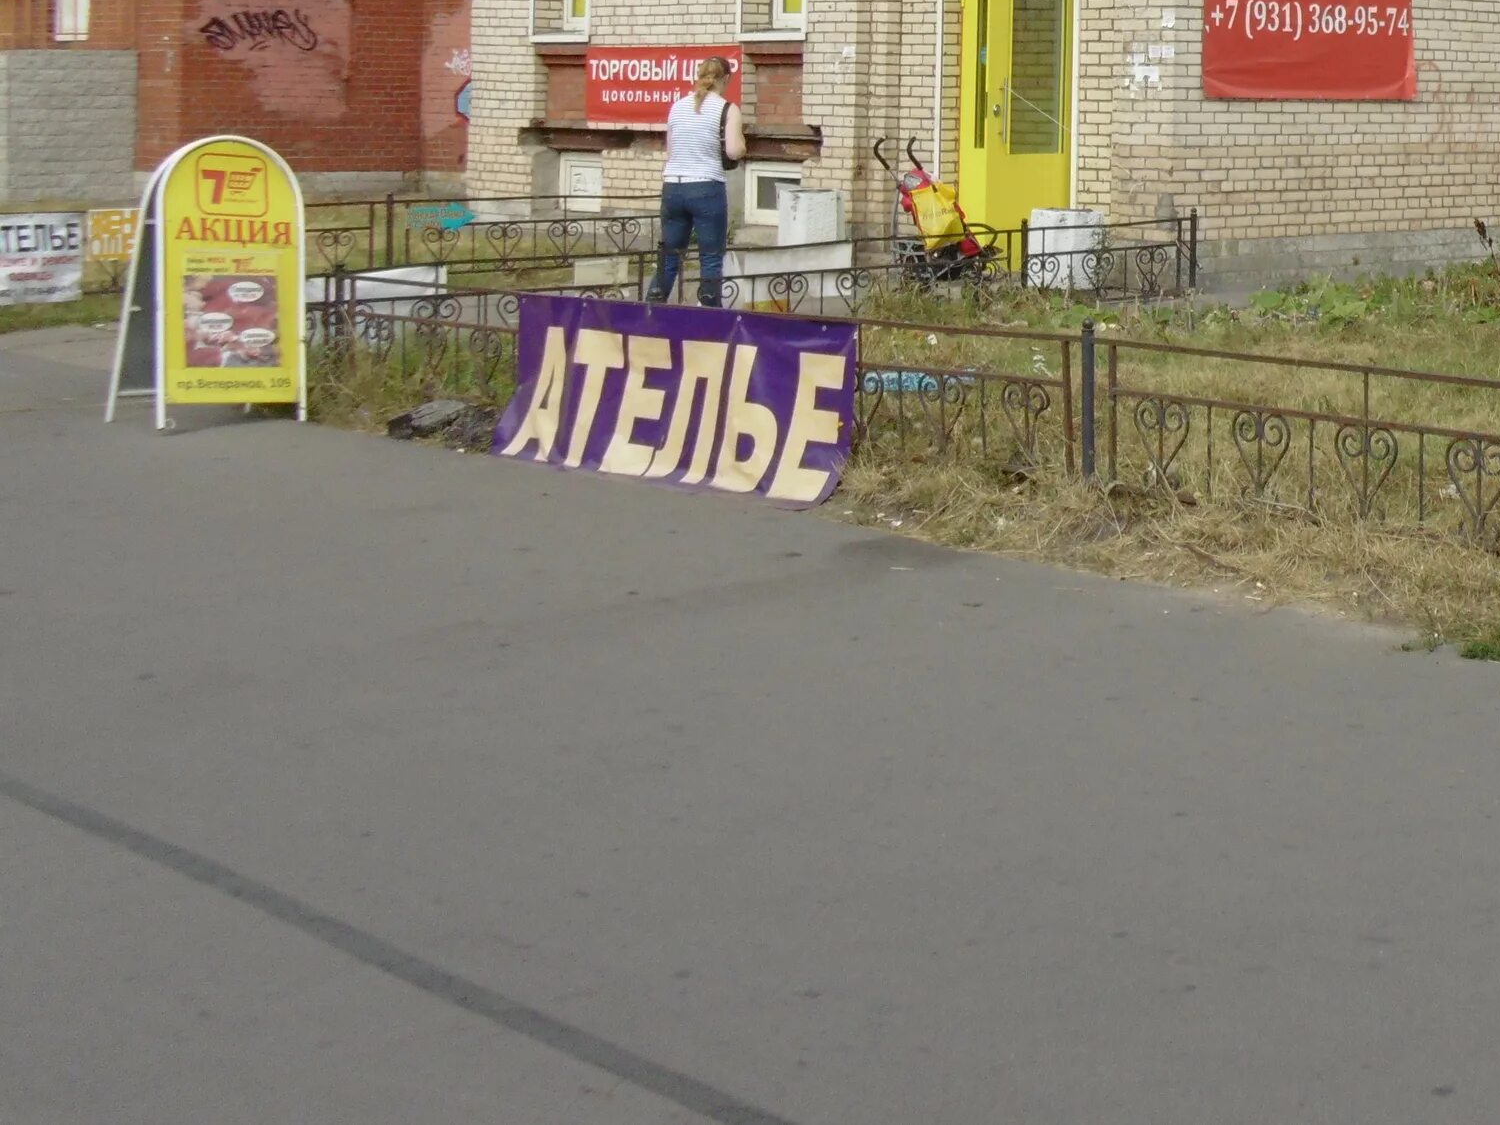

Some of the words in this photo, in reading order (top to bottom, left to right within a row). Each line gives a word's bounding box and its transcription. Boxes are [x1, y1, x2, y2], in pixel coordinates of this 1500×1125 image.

[1308, 3, 1410, 37] 368-95-74
[589, 55, 678, 81] ТОРГОВЫЙ
[602, 87, 681, 104] цокольный
[175, 216, 293, 249] АКЦИЯ
[500, 325, 847, 502] АТЕЛЬЕ
